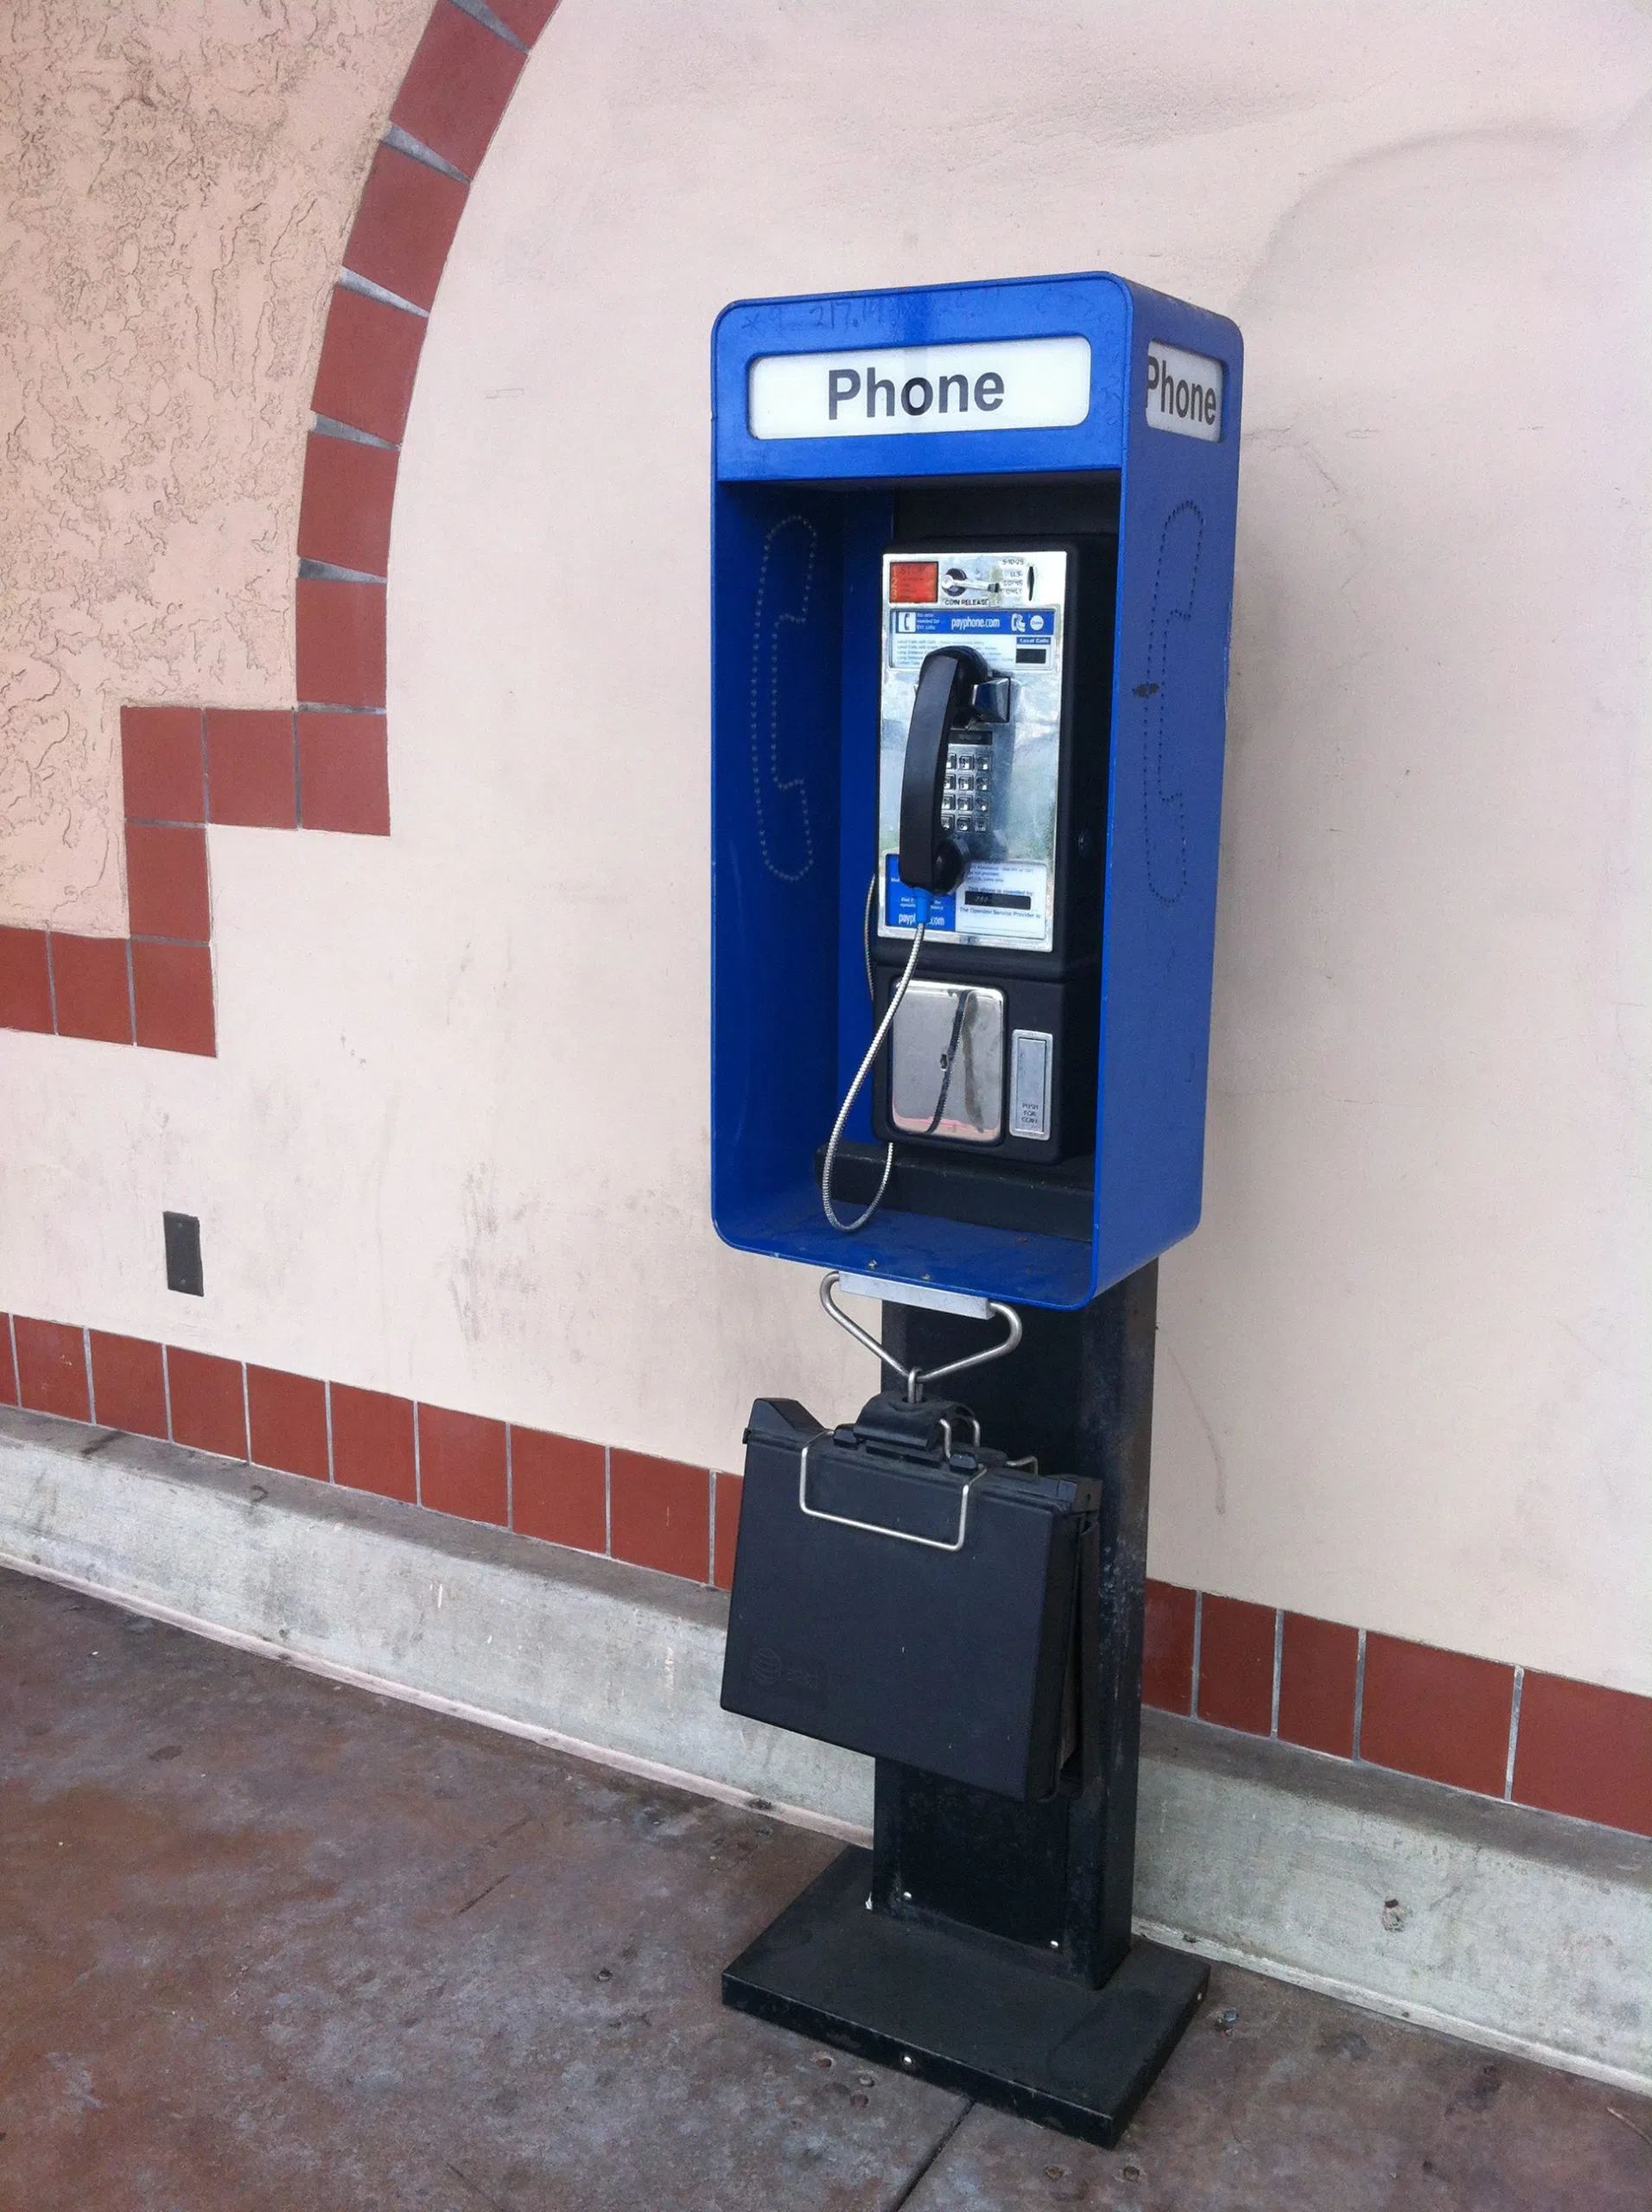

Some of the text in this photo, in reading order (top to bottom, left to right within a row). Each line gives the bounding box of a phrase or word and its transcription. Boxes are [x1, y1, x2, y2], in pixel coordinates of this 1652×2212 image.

[828, 369, 1006, 421] Phone
[1146, 355, 1217, 425] Phone
[951, 616, 1001, 630] payphone.com
